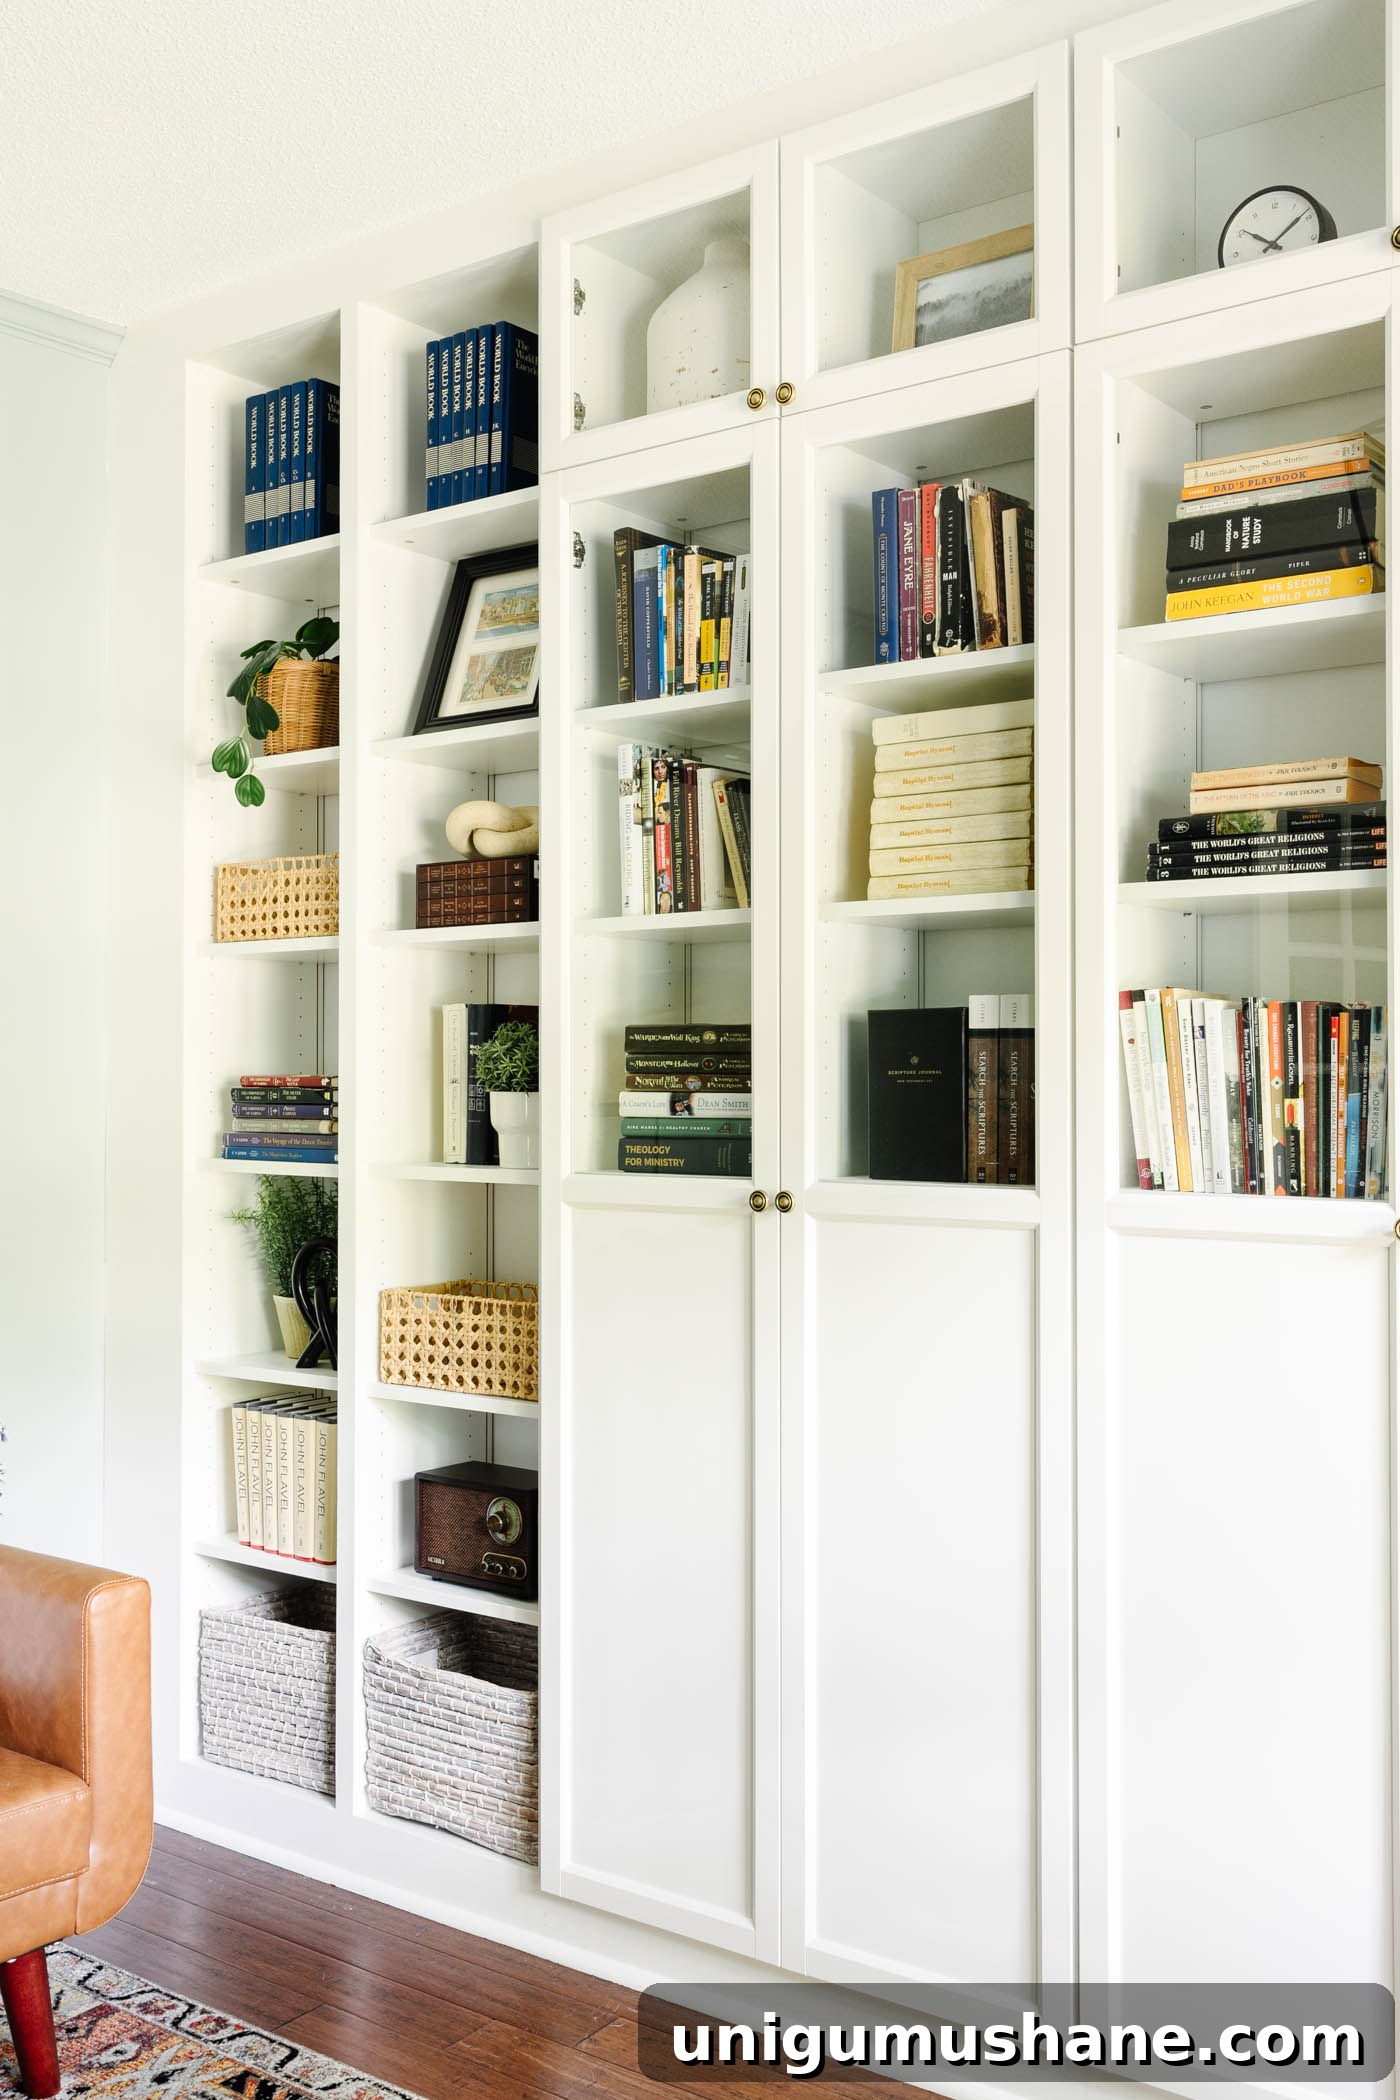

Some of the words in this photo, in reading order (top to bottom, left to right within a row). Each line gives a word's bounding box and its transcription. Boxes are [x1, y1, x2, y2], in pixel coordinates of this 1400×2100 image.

[441, 349, 449, 387] WORLD
[453, 345, 461, 383] WORLD
[478, 337, 486, 375] WORLD
[1213, 482, 1244, 492] DAD'S
[1248, 472, 1307, 486] PLAYBOOK
[903, 521, 913, 555] JANE
[1233, 530, 1239, 539] OF
[1241, 516, 1251, 549] NATURE
[1253, 518, 1262, 544] STUDY
[904, 557, 913, 590] EYRE
[923, 557, 935, 609] FAHRENHEIT
[942, 571, 958, 582] MAN
[1187, 572, 1227, 583] PECULIAR
[1230, 568, 1256, 576] GLORY
[1288, 560, 1310, 568] PIPER
[1263, 582, 1282, 592] THE
[1287, 575, 1332, 589] SECOND
[1171, 599, 1202, 611] JOHN
[1205, 592, 1255, 607] KEEGAN
[1263, 591, 1302, 604] WORLD
[1306, 587, 1330, 598] WAR
[622, 607, 627, 619] TO
[672, 770, 680, 784] Fall
[673, 809, 681, 839] Dreams
[1191, 841, 1209, 850] THE
[1210, 838, 1246, 847] WORLD'S
[1248, 836, 1277, 845] GREAT
[1277, 832, 1324, 843] RELIGIONS
[1371, 828, 1385, 836] LIFE
[1163, 857, 1172, 865] 2
[1194, 855, 1212, 863] THE
[1213, 851, 1250, 861] WORLD'S
[1251, 850, 1279, 859] GREAT
[1281, 846, 1329, 857] RELIGIONS
[1192, 868, 1210, 876] THE
[1211, 866, 1247, 875] WORLD'S
[1249, 864, 1277, 873] GREAT
[1279, 862, 1327, 872] RELIGIONS
[674, 858, 683, 894] Reynolds
[1351, 1019, 1360, 1041] KEEPING
[978, 1050, 986, 1086] SEARCH
[1010, 1050, 1018, 1086] SEARCH
[697, 1096, 720, 1107] DEAN
[721, 1098, 748, 1108] SMITH
[1371, 1091, 1380, 1139] MORRISON
[978, 1100, 986, 1155] SCRIPTURES
[1009, 1101, 1017, 1156] SCRIPTURES
[625, 1145, 671, 1154] THEOLOGY
[625, 1158, 642, 1166] FOR
[644, 1157, 685, 1167] MINISTRY
[235, 1416, 245, 1450] JOHN
[250, 1418, 259, 1454] JOHN
[265, 1421, 273, 1458] JOHN
[280, 1424, 288, 1461] JOHN
[297, 1426, 305, 1464] JOHN
[318, 1429, 327, 1467] JOHN
[237, 1454, 246, 1503] FLAVEL
[251, 1458, 260, 1506] FLAVEL
[265, 1462, 273, 1511] FLAVEL
[280, 1465, 288, 1513] FLAVEL
[297, 1467, 305, 1519] FLAVEL
[317, 1471, 326, 1520] FLAVEL
